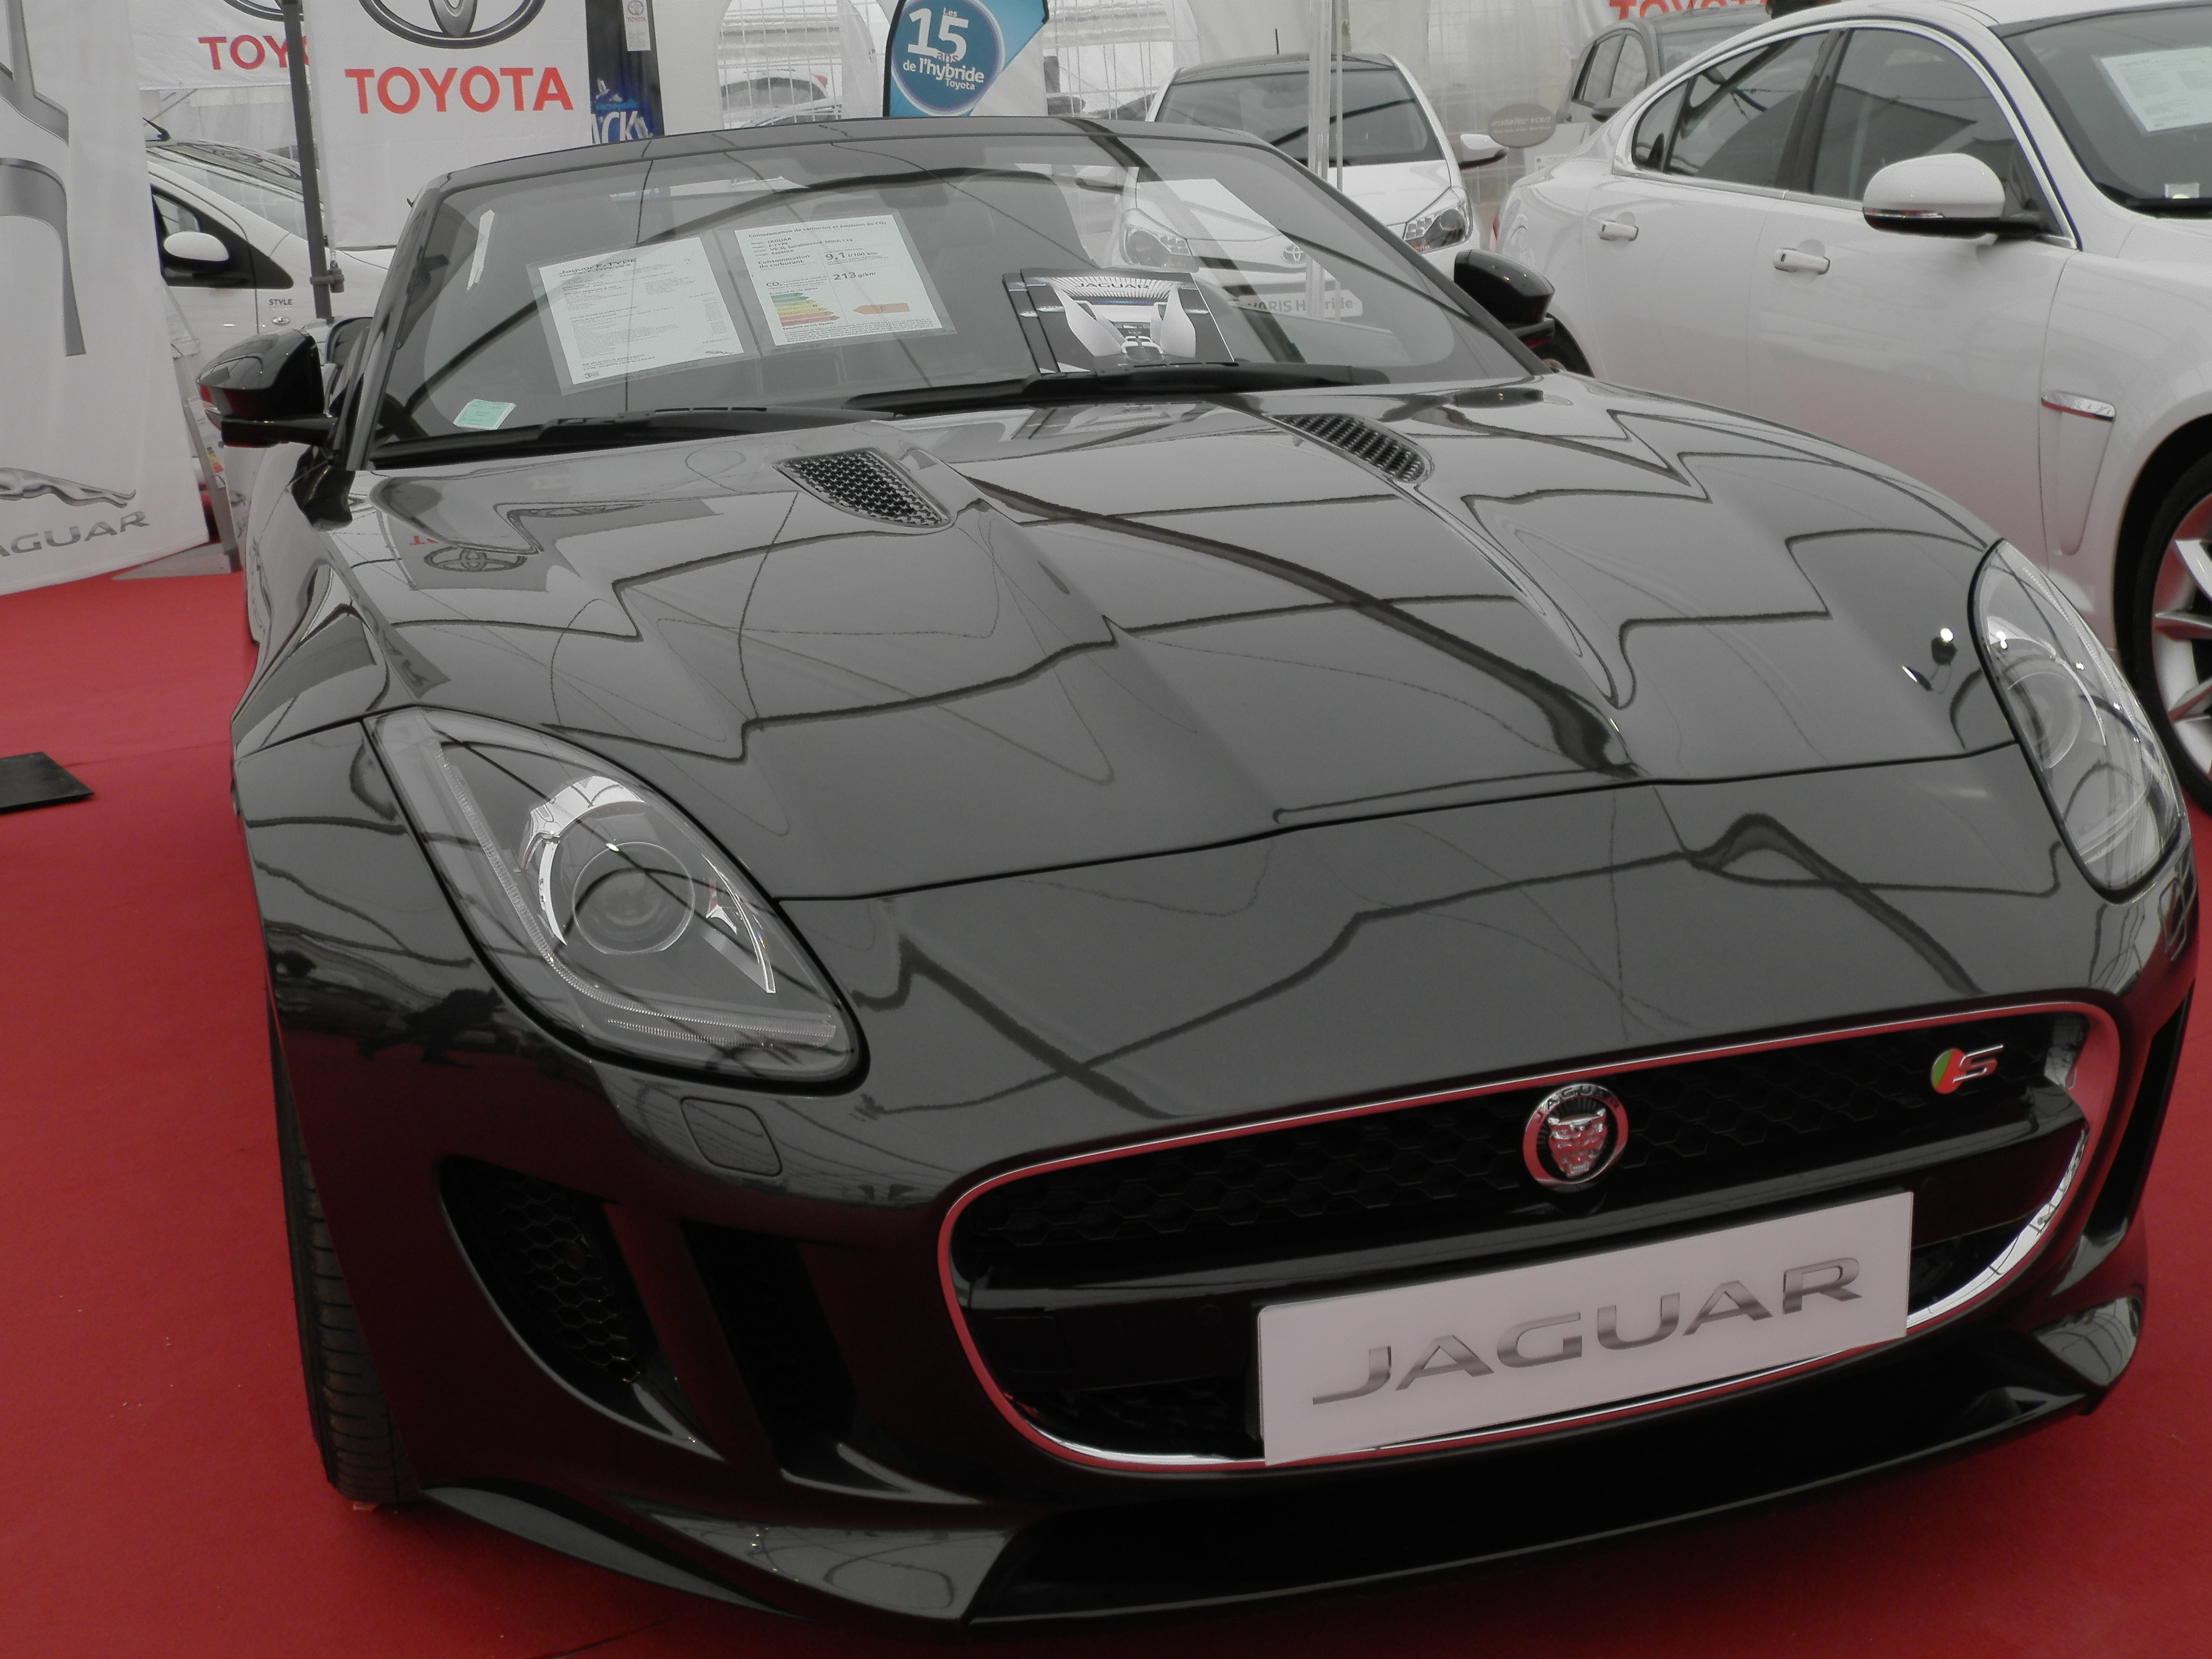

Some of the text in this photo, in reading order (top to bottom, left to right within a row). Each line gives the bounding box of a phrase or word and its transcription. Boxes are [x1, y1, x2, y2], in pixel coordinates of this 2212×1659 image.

[943, 7, 958, 17] Les
[907, 7, 969, 61] 15
[198, 35, 309, 70] TOY
[936, 52, 959, 63] ans
[902, 57, 985, 83] de l'hybride
[345, 66, 573, 114] TOYOTA
[945, 78, 975, 90] Toyota
[749, 229, 793, 238] Consommation
[559, 265, 594, 275] Jaguar
[596, 258, 637, 268] F-TYPE
[758, 255, 810, 264] Consommation
[833, 272, 856, 280] 213
[1534, 1085, 1619, 1124] JAGUAR
[1313, 1257, 1862, 1406] JAGUAR
